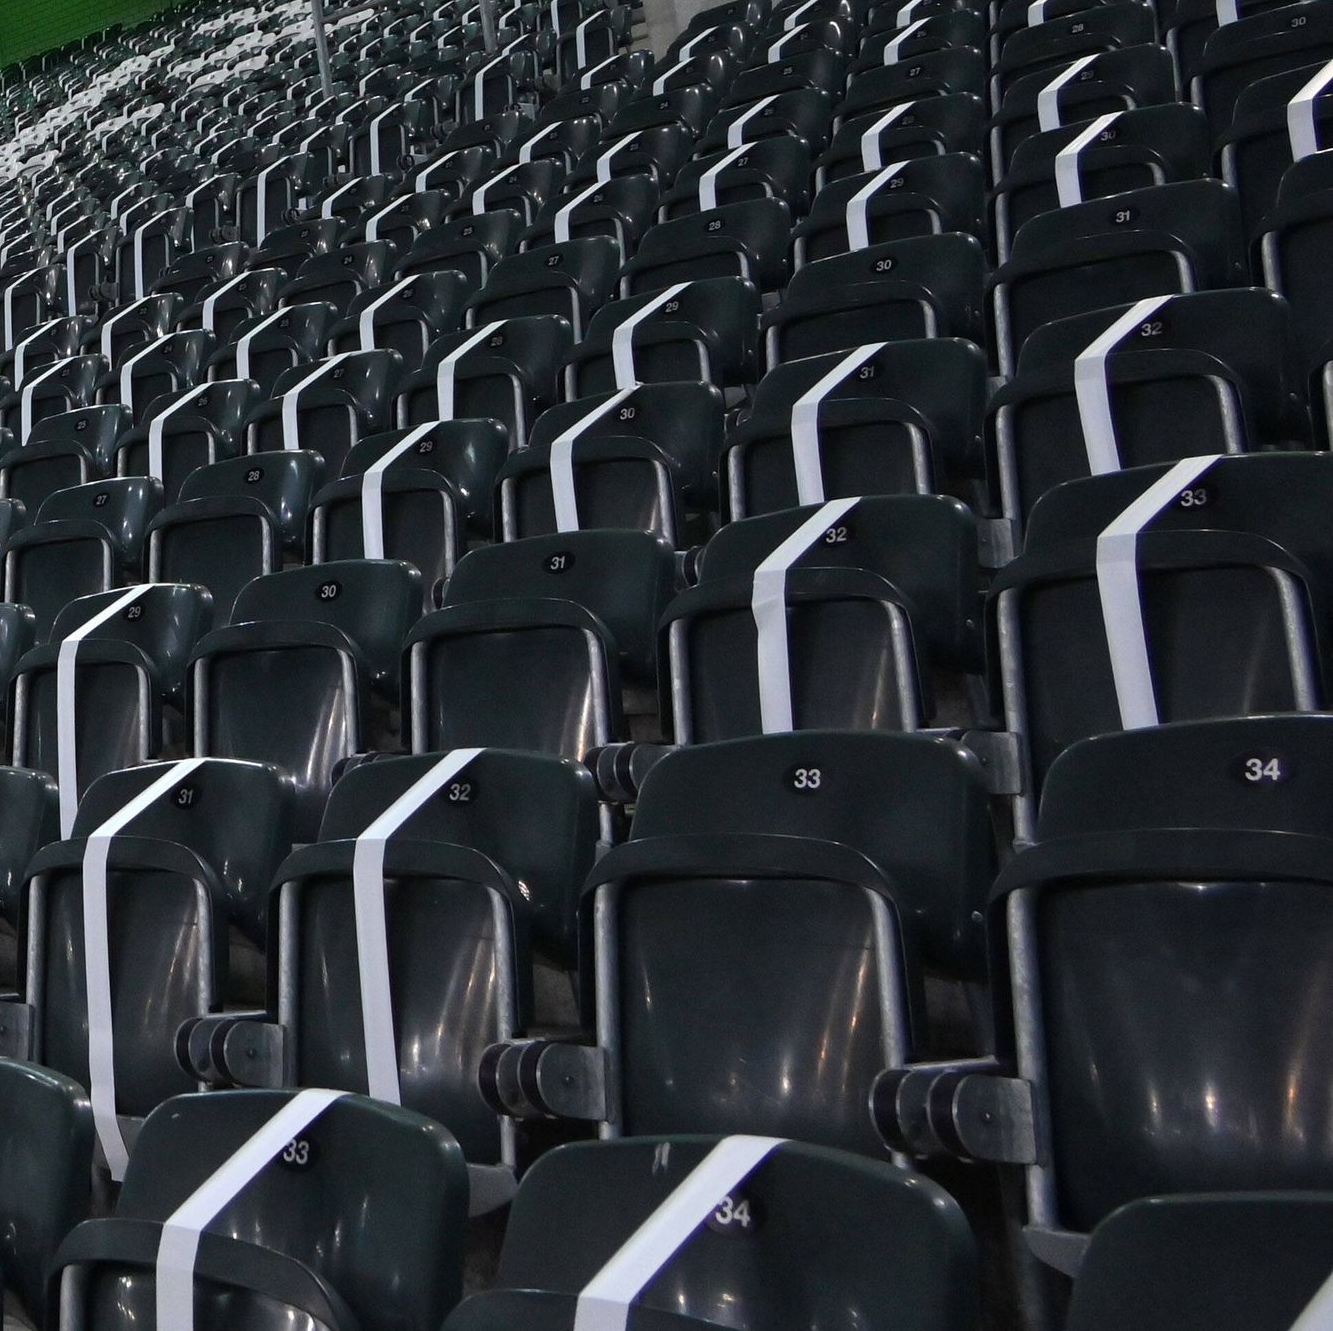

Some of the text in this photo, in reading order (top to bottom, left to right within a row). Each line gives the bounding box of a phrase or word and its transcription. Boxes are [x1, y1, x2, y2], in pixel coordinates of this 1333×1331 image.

[1290, 16, 1306, 28] 30
[1100, 130, 1116, 141] 30
[890, 177, 904, 188] 29
[1116, 210, 1131, 223] 31
[709, 221, 721, 231] 28
[548, 255, 559, 265] 27
[876, 259, 892, 271] 30
[665, 301, 679, 312] 29
[1140, 322, 1163, 337] 32
[859, 365, 875, 378] 31
[619, 407, 635, 420] 30
[419, 441, 433, 453] 29
[247, 470, 260, 481] 28
[95, 495, 107, 505] 27
[1180, 488, 1207, 508] 33
[825, 526, 847, 544] 32
[550, 555, 566, 571] 31
[321, 584, 337, 598] 30
[128, 606, 142, 618] 29
[1245, 758, 1281, 782] 34
[793, 768, 822, 789] 33
[178, 789, 194, 805] 31
[449, 783, 471, 802] 32
[282, 1140, 310, 1165] 33
[714, 1198, 751, 1227] 34
